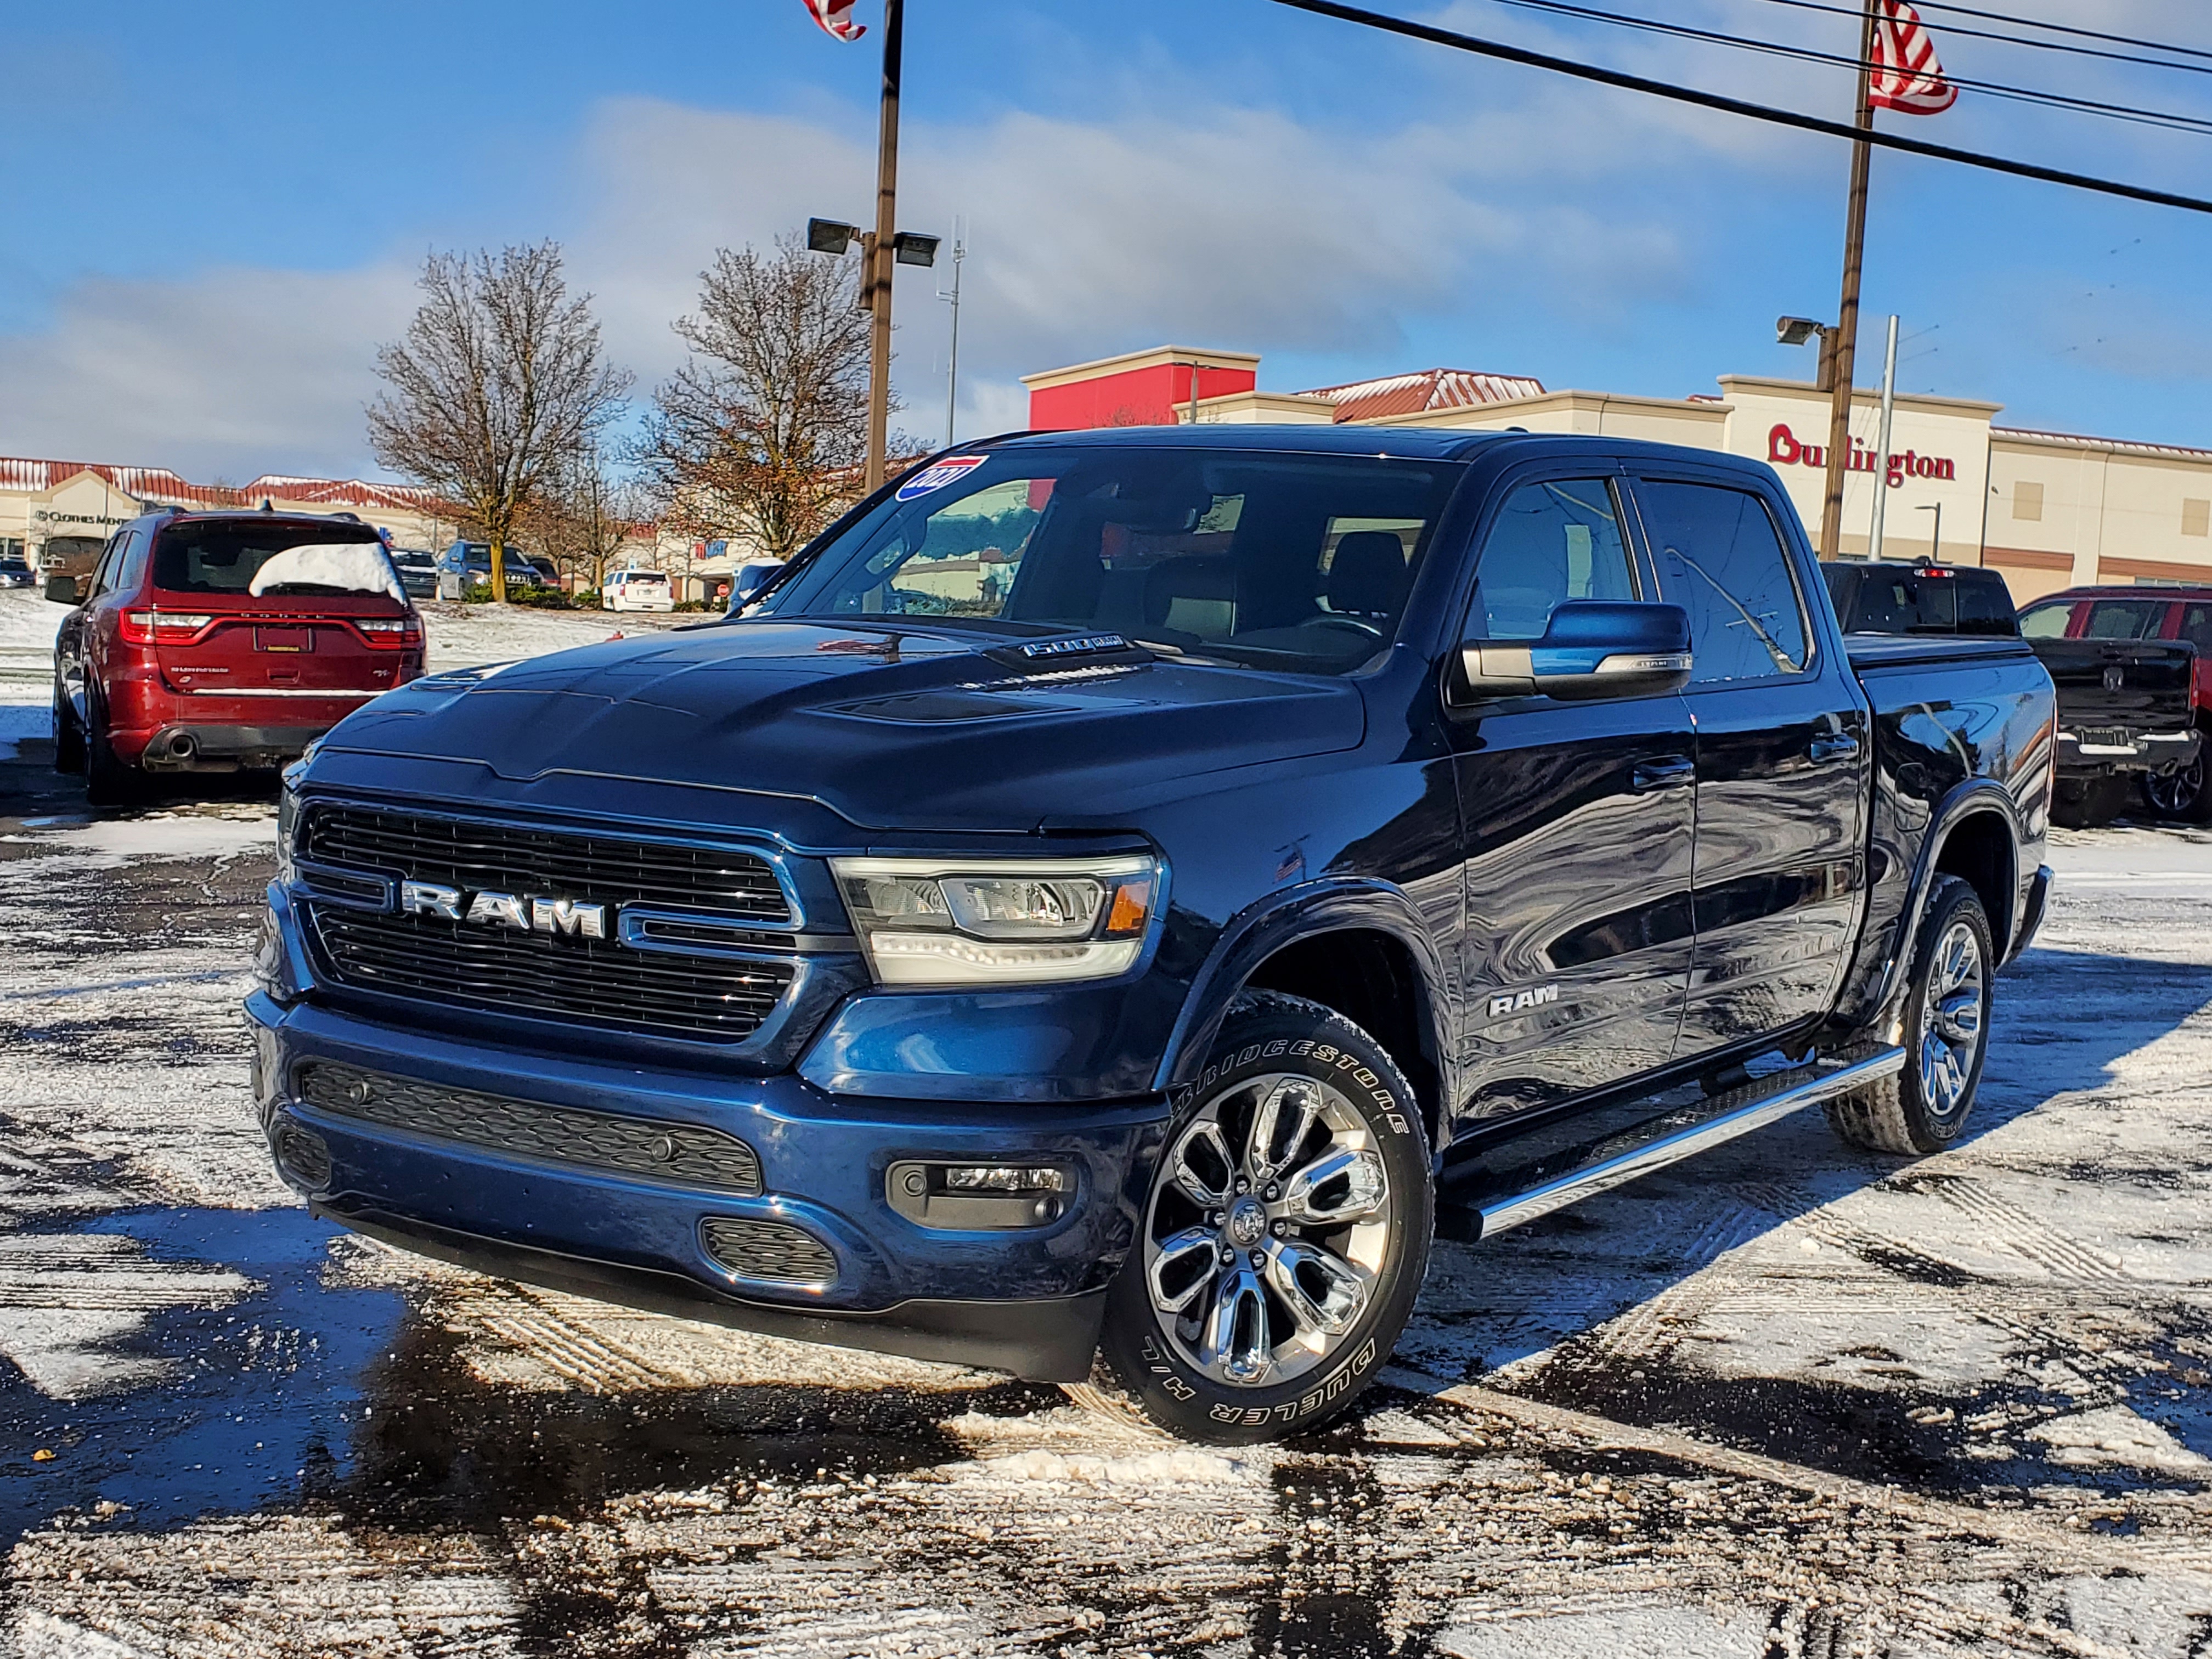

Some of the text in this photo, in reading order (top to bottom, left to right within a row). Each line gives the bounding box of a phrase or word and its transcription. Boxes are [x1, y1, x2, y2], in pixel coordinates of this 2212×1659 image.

[904, 467, 968, 489] 2021
[1768, 424, 1956, 488] Bulington
[1018, 639, 1096, 657] 1500
[402, 880, 605, 939] RAM
[1489, 984, 1559, 1018] RAM
[1171, 1039, 1410, 1135] BRIDGESTONE
[1206, 1337, 1376, 1426] DUELER
